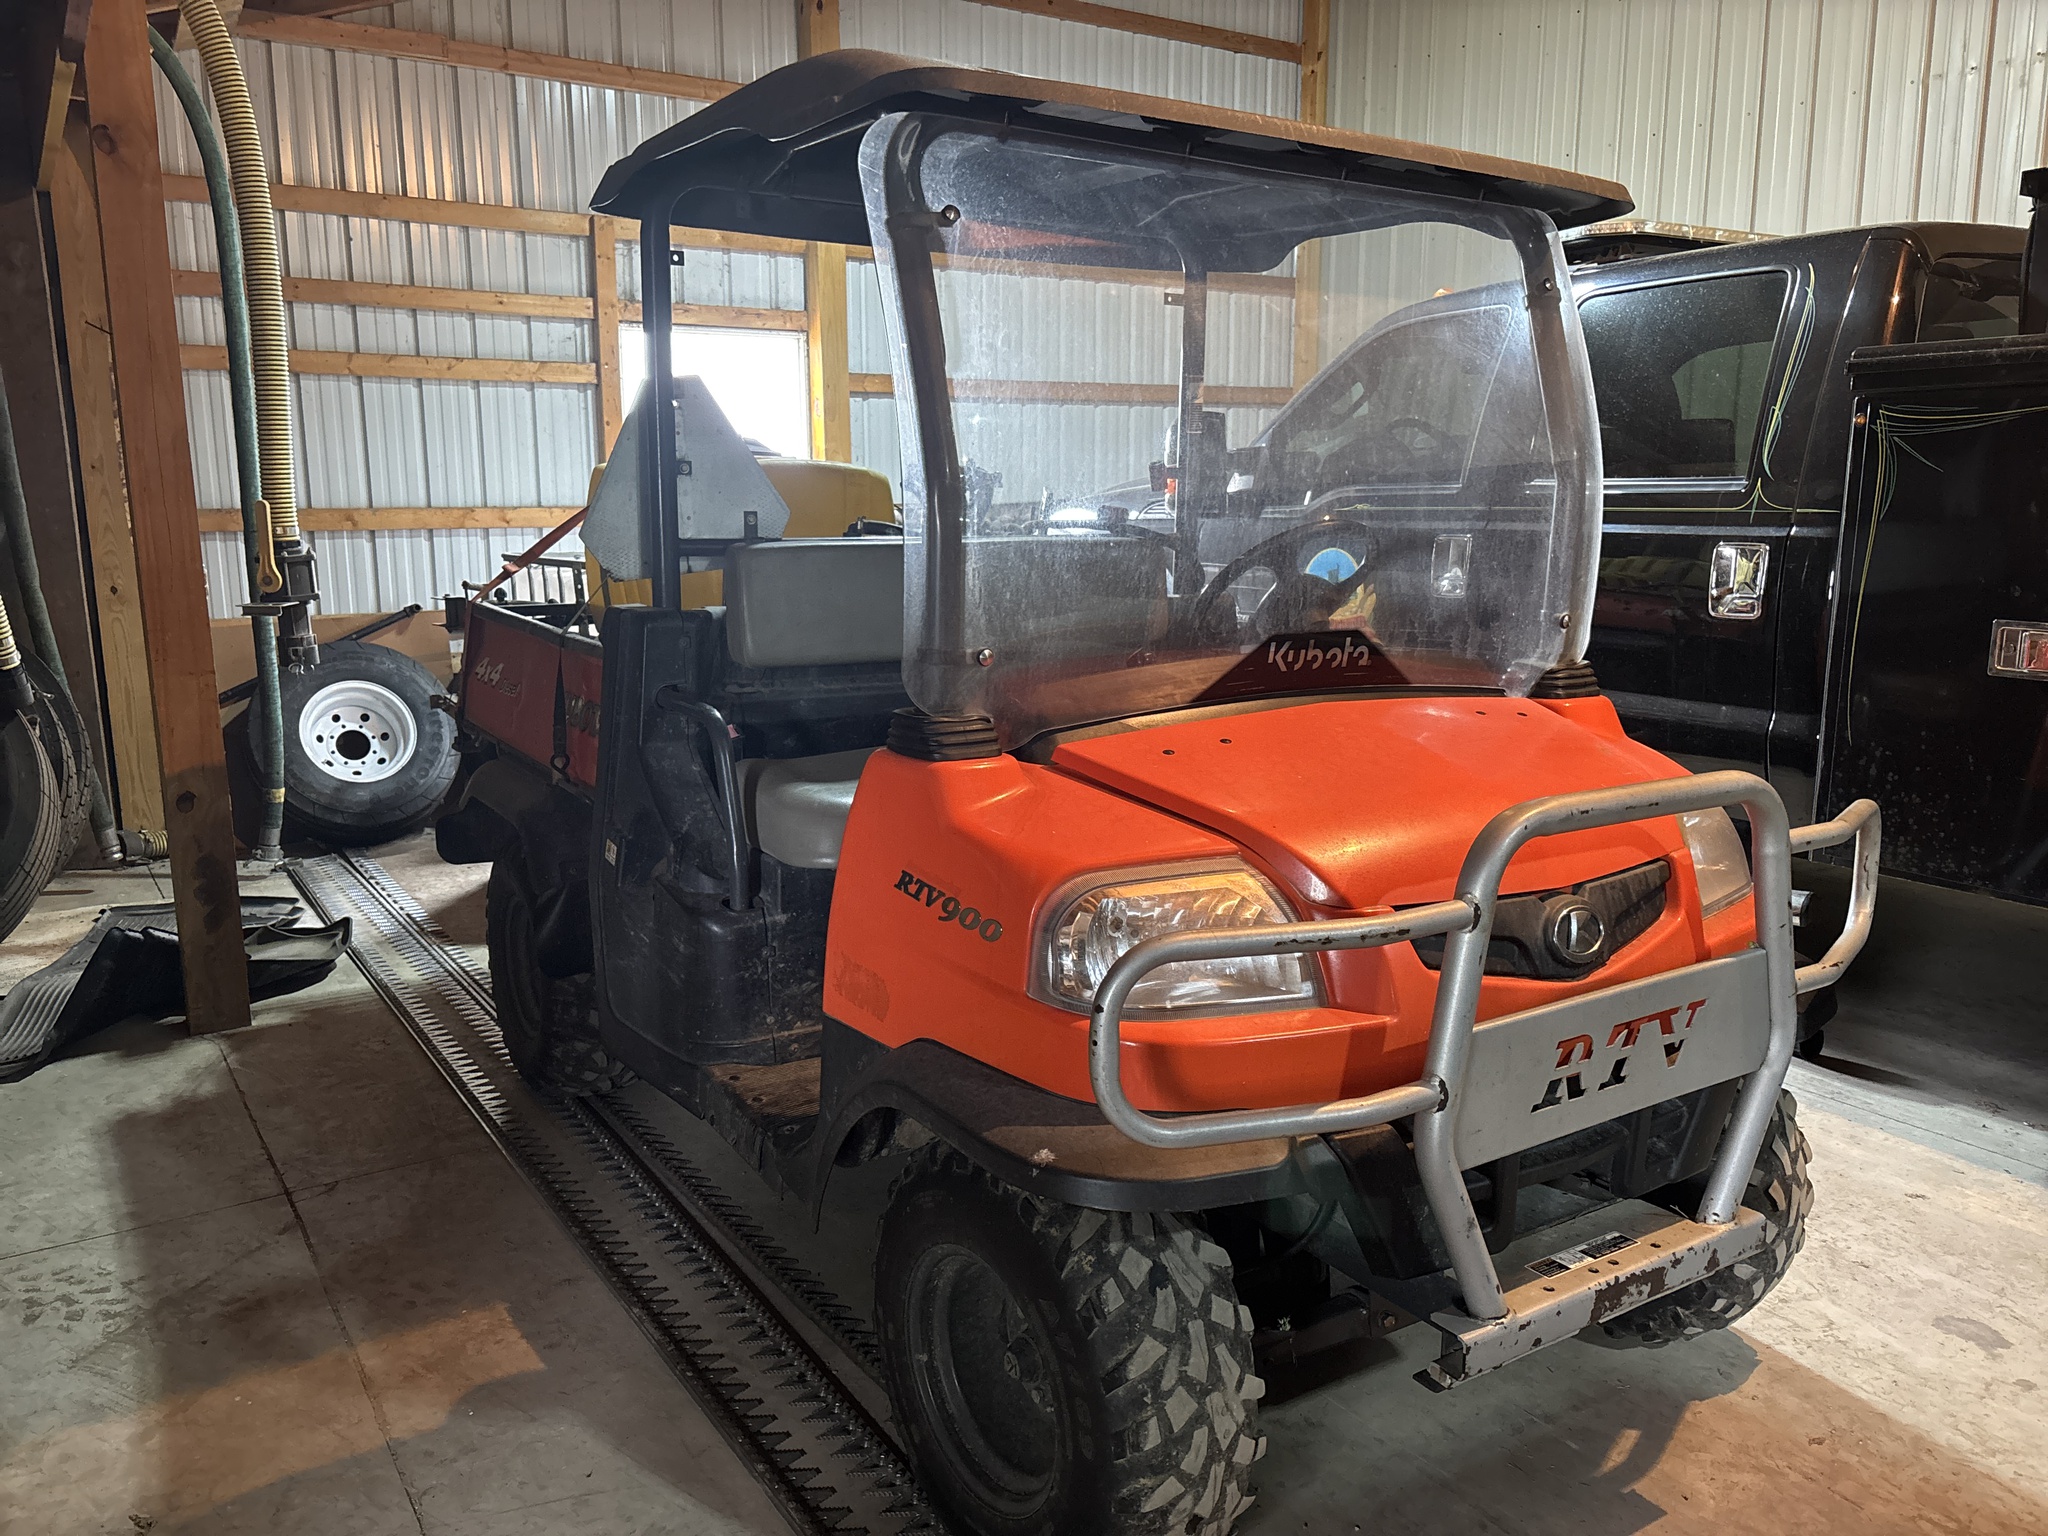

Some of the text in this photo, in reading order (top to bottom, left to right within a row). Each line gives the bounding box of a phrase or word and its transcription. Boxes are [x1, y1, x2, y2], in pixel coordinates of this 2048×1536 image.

[475, 656, 505, 687] 4x4
[1267, 636, 1370, 673] Kubota
[893, 869, 1004, 943] RTV900
[1530, 998, 1708, 1115] RTV
